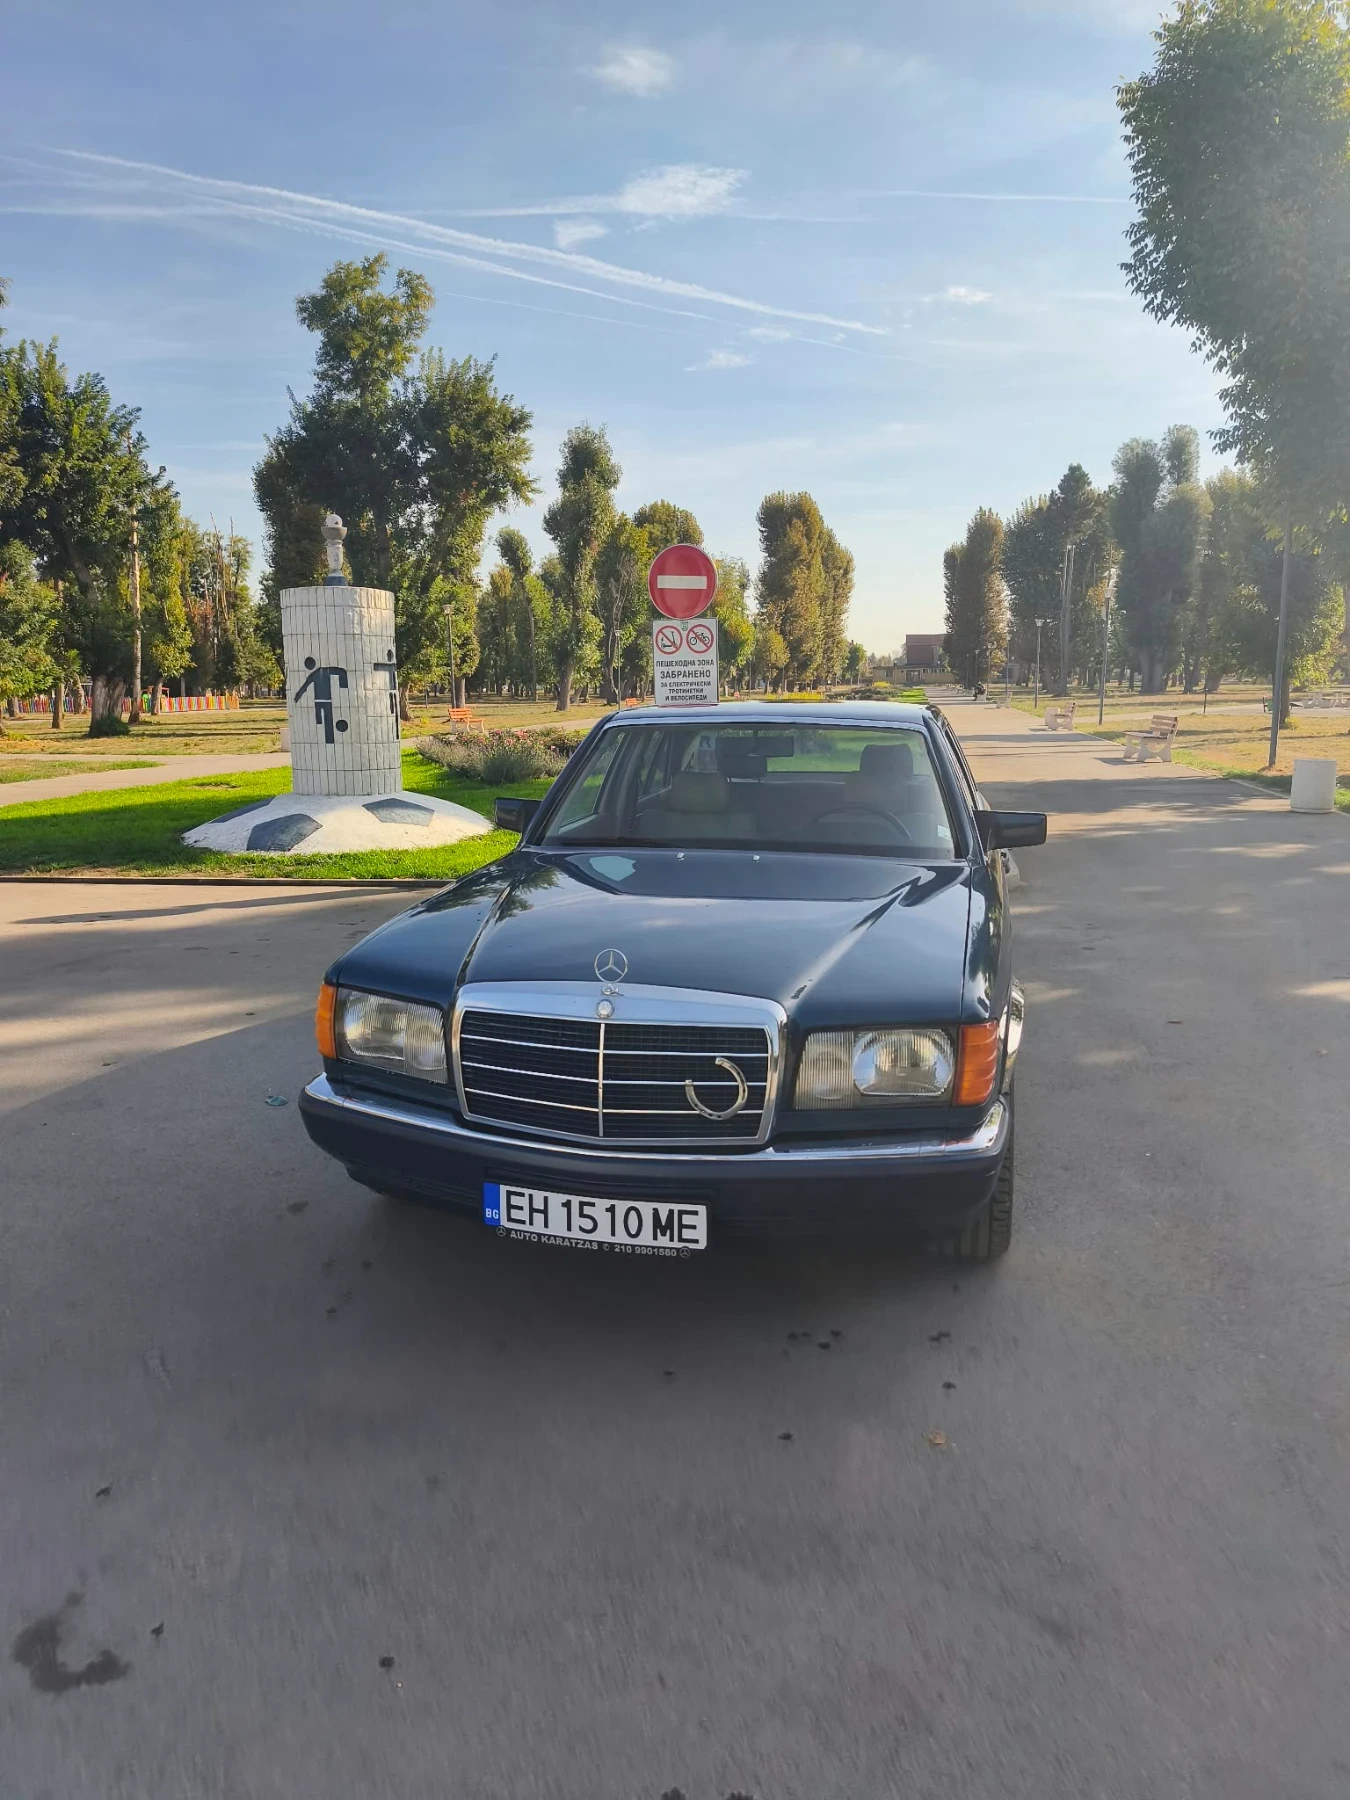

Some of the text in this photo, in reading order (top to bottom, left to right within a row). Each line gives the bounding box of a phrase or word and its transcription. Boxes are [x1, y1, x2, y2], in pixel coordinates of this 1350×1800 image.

[660, 670, 710, 679] ЗАБРАНЕНО
[485, 1208, 499, 1219] BG
[505, 1190, 700, 1244] EH 1510 ME
[510, 1230, 538, 1241] AUTO
[541, 1235, 598, 1250] KARATZAS
[614, 1244, 632, 1253] 210
